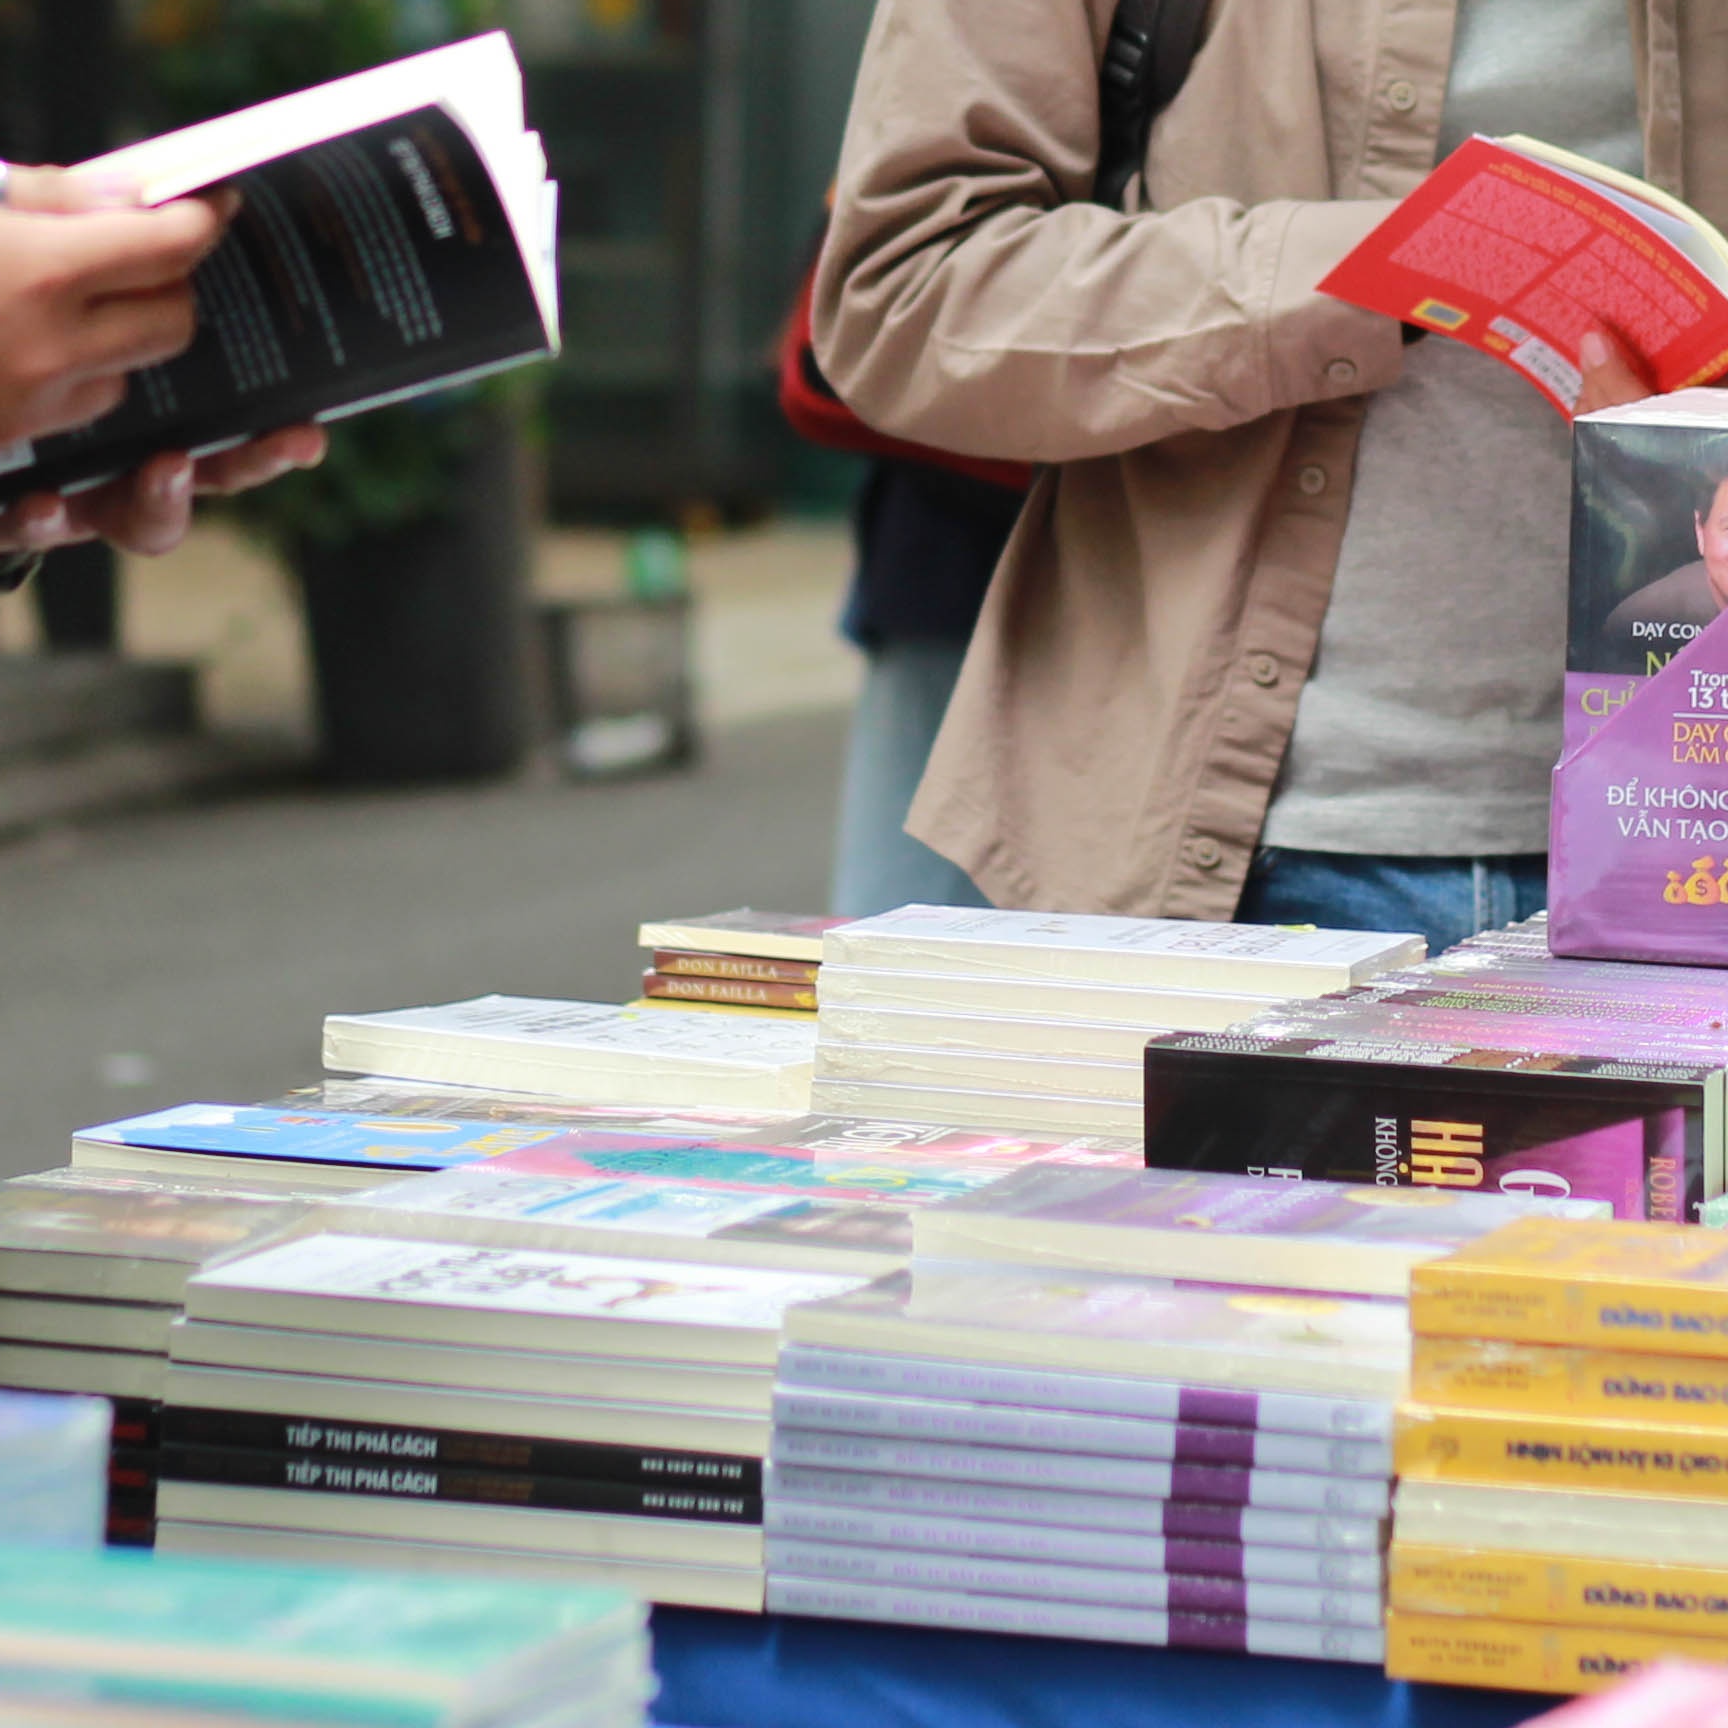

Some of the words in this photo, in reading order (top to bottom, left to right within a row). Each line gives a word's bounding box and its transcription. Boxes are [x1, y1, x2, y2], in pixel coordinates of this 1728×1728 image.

[1632, 622, 1666, 640] DẠY
[1688, 686, 1714, 709] 13
[1673, 722, 1719, 747] DẠY
[1606, 777, 1640, 807] ĐỂ
[1617, 808, 1671, 839] VẪN
[1676, 819, 1728, 845] TẠO
[676, 957, 715, 973] DON
[720, 962, 779, 979] FAILLA
[666, 980, 705, 995] DON
[710, 985, 768, 1001] FAILLA
